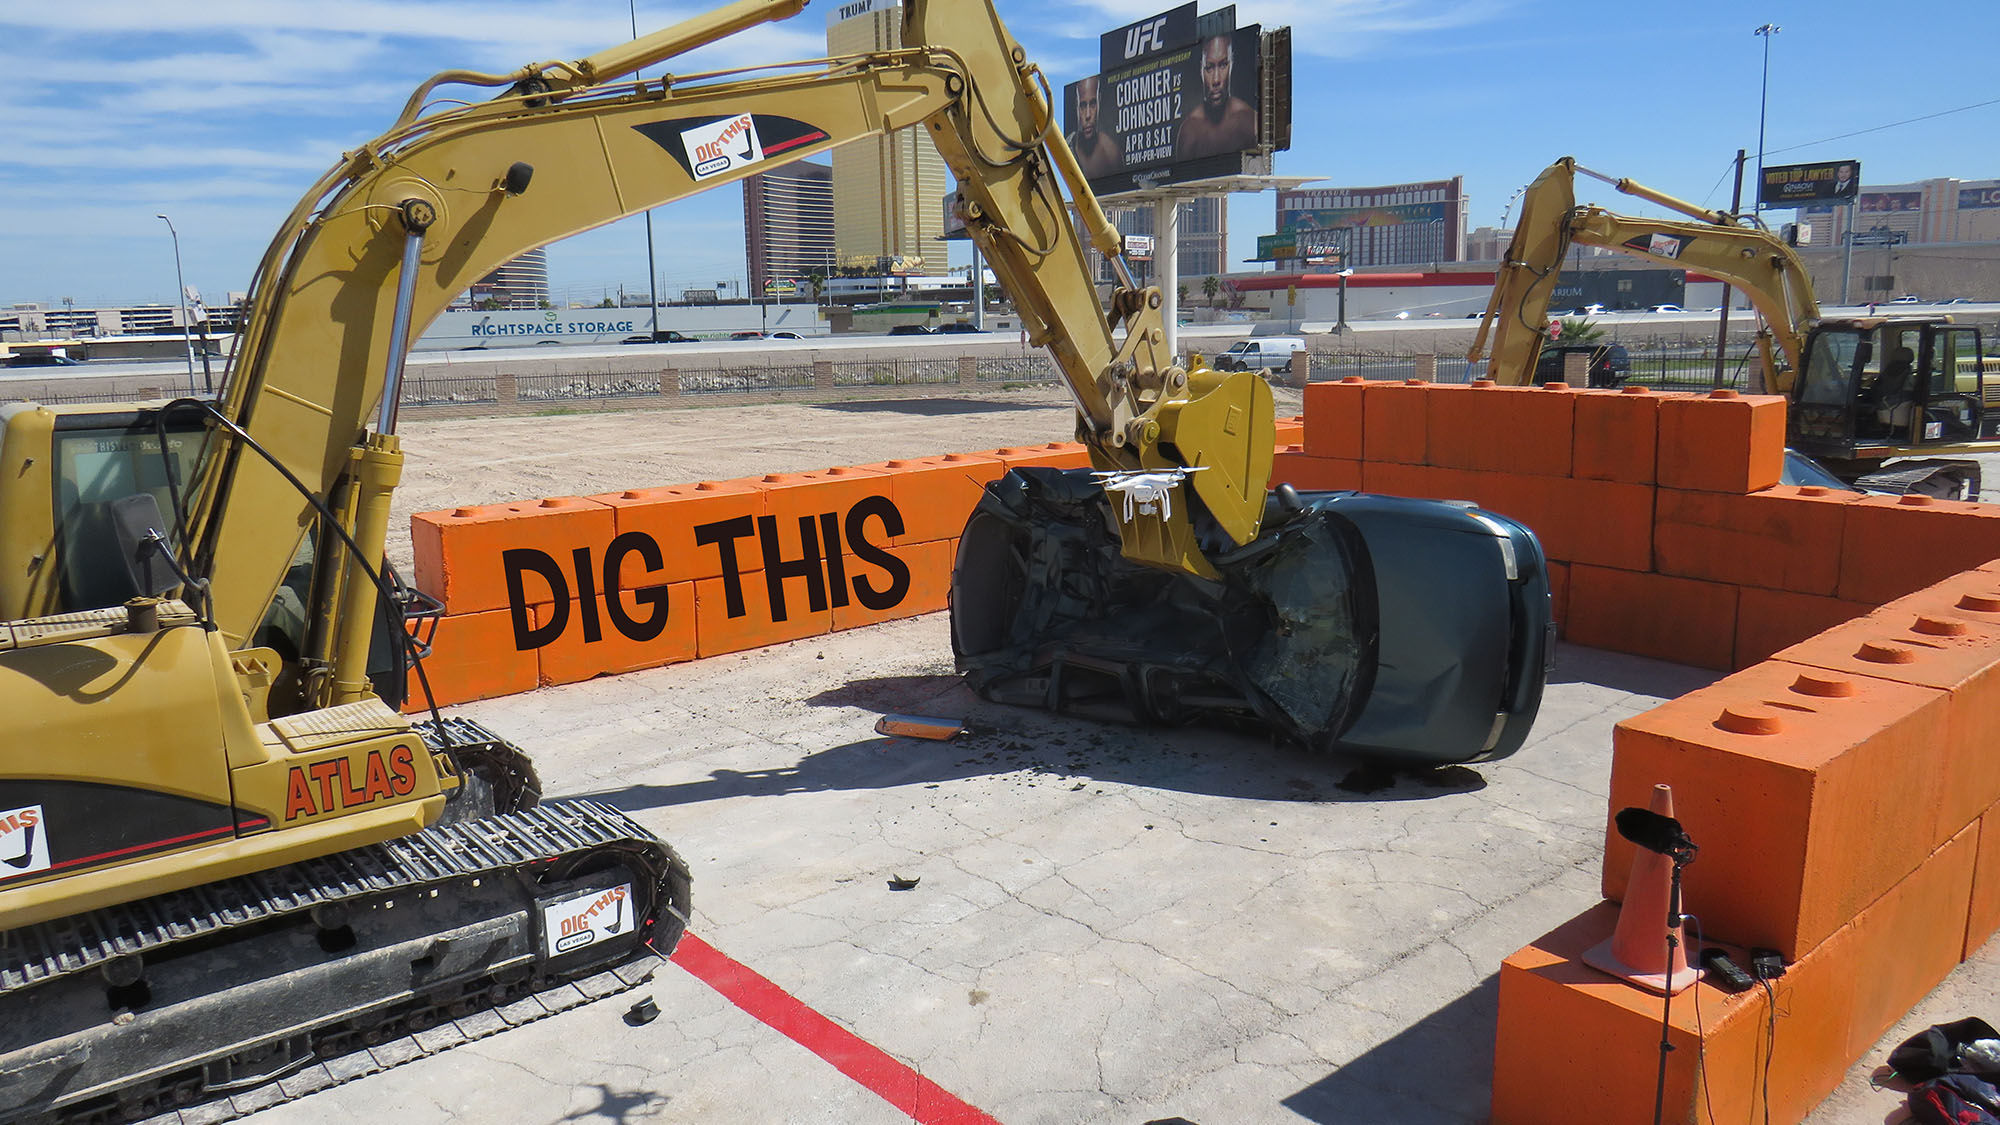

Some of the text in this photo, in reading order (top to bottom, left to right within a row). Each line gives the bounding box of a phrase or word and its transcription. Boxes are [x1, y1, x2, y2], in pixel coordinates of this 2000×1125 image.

[839, 0, 873, 20] TRUMP
[1124, 16, 1168, 60] UFC
[1116, 69, 1171, 108] CORMIER
[1115, 94, 1182, 134] JOHNSON 2
[695, 116, 752, 162] DIG THIS
[1126, 126, 1172, 153] APR 8 SAT
[698, 160, 728, 173] LAS VEGAS
[1131, 145, 1173, 164] PAY-PER-VIEW
[1765, 168, 1835, 184] VOTED TOP LAWYER
[1304, 184, 1425, 198] TREASURE ISLAND
[471, 321, 633, 336] RIGHTSPACE STORAGE
[502, 495, 911, 651] DIG THIS
[285, 744, 416, 822] ATLAS
[560, 885, 625, 936] DIG THIS
[559, 934, 592, 948] LAS VEGAS
